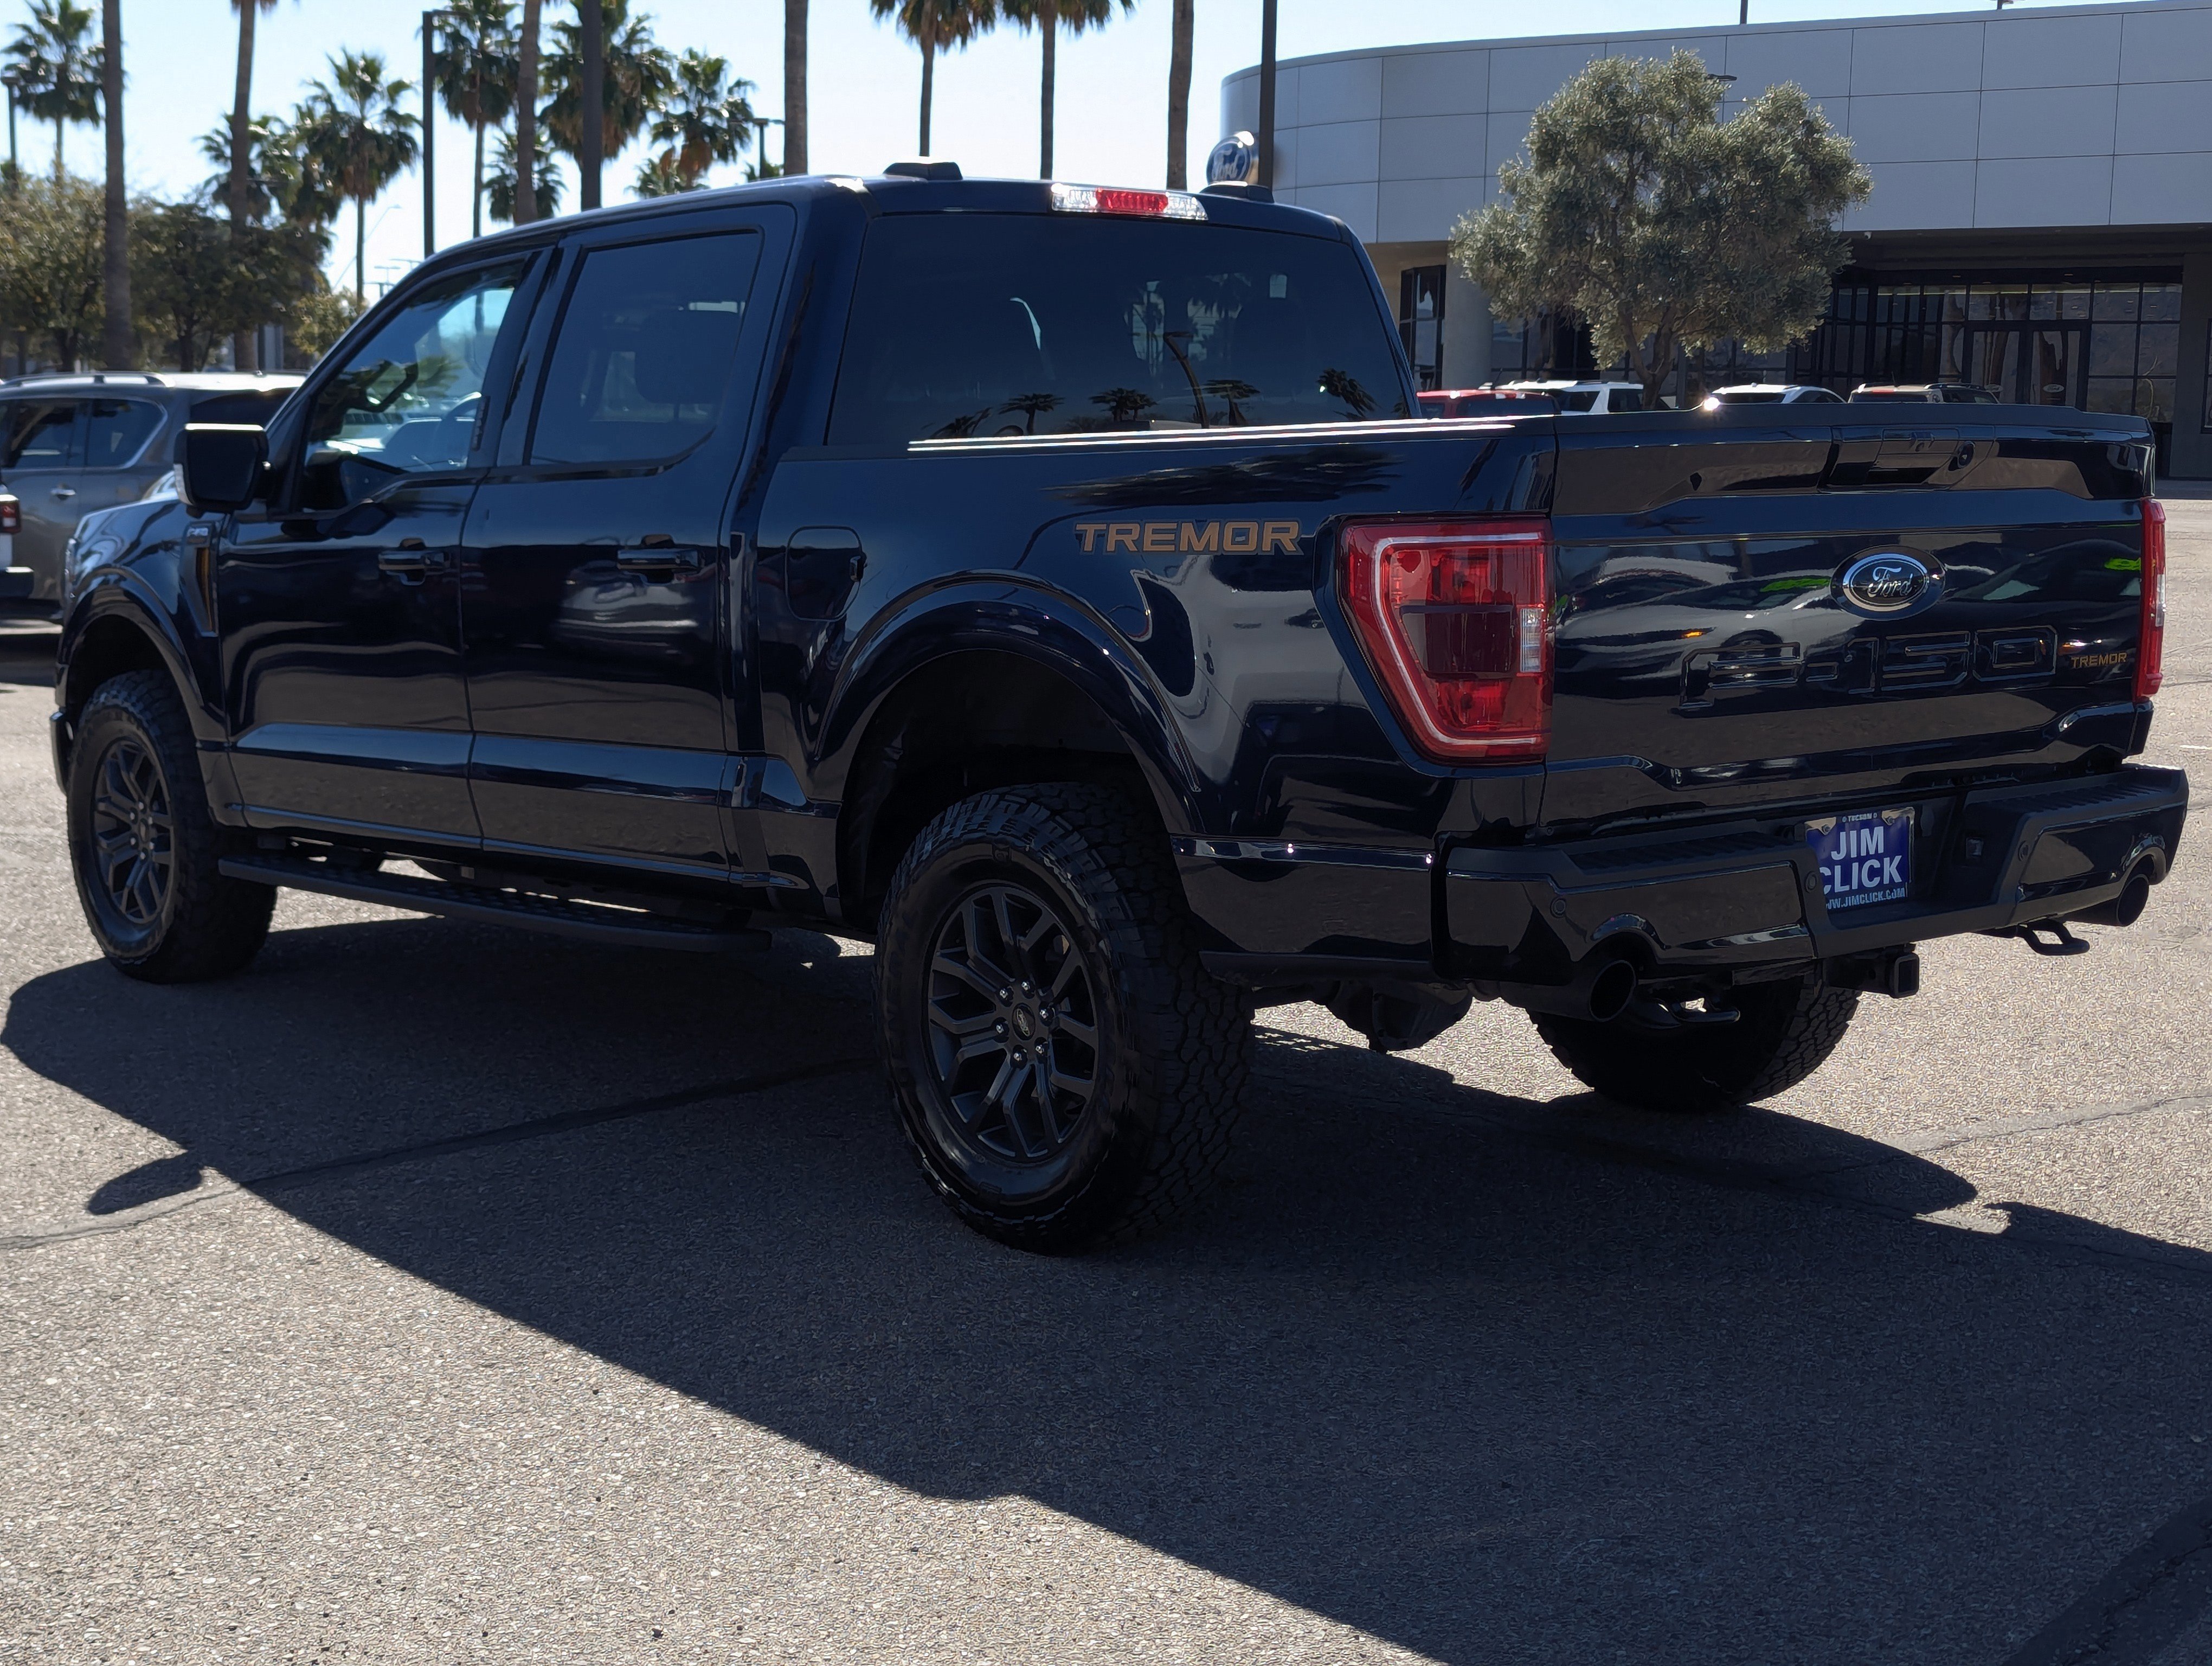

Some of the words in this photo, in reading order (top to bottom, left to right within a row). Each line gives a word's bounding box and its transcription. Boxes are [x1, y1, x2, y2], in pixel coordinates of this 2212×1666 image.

[1076, 521, 1298, 551] TREMOR
[1867, 566, 1913, 597] Ford
[2071, 652, 2127, 668] TREMOR
[1831, 826, 1884, 861] JIM
